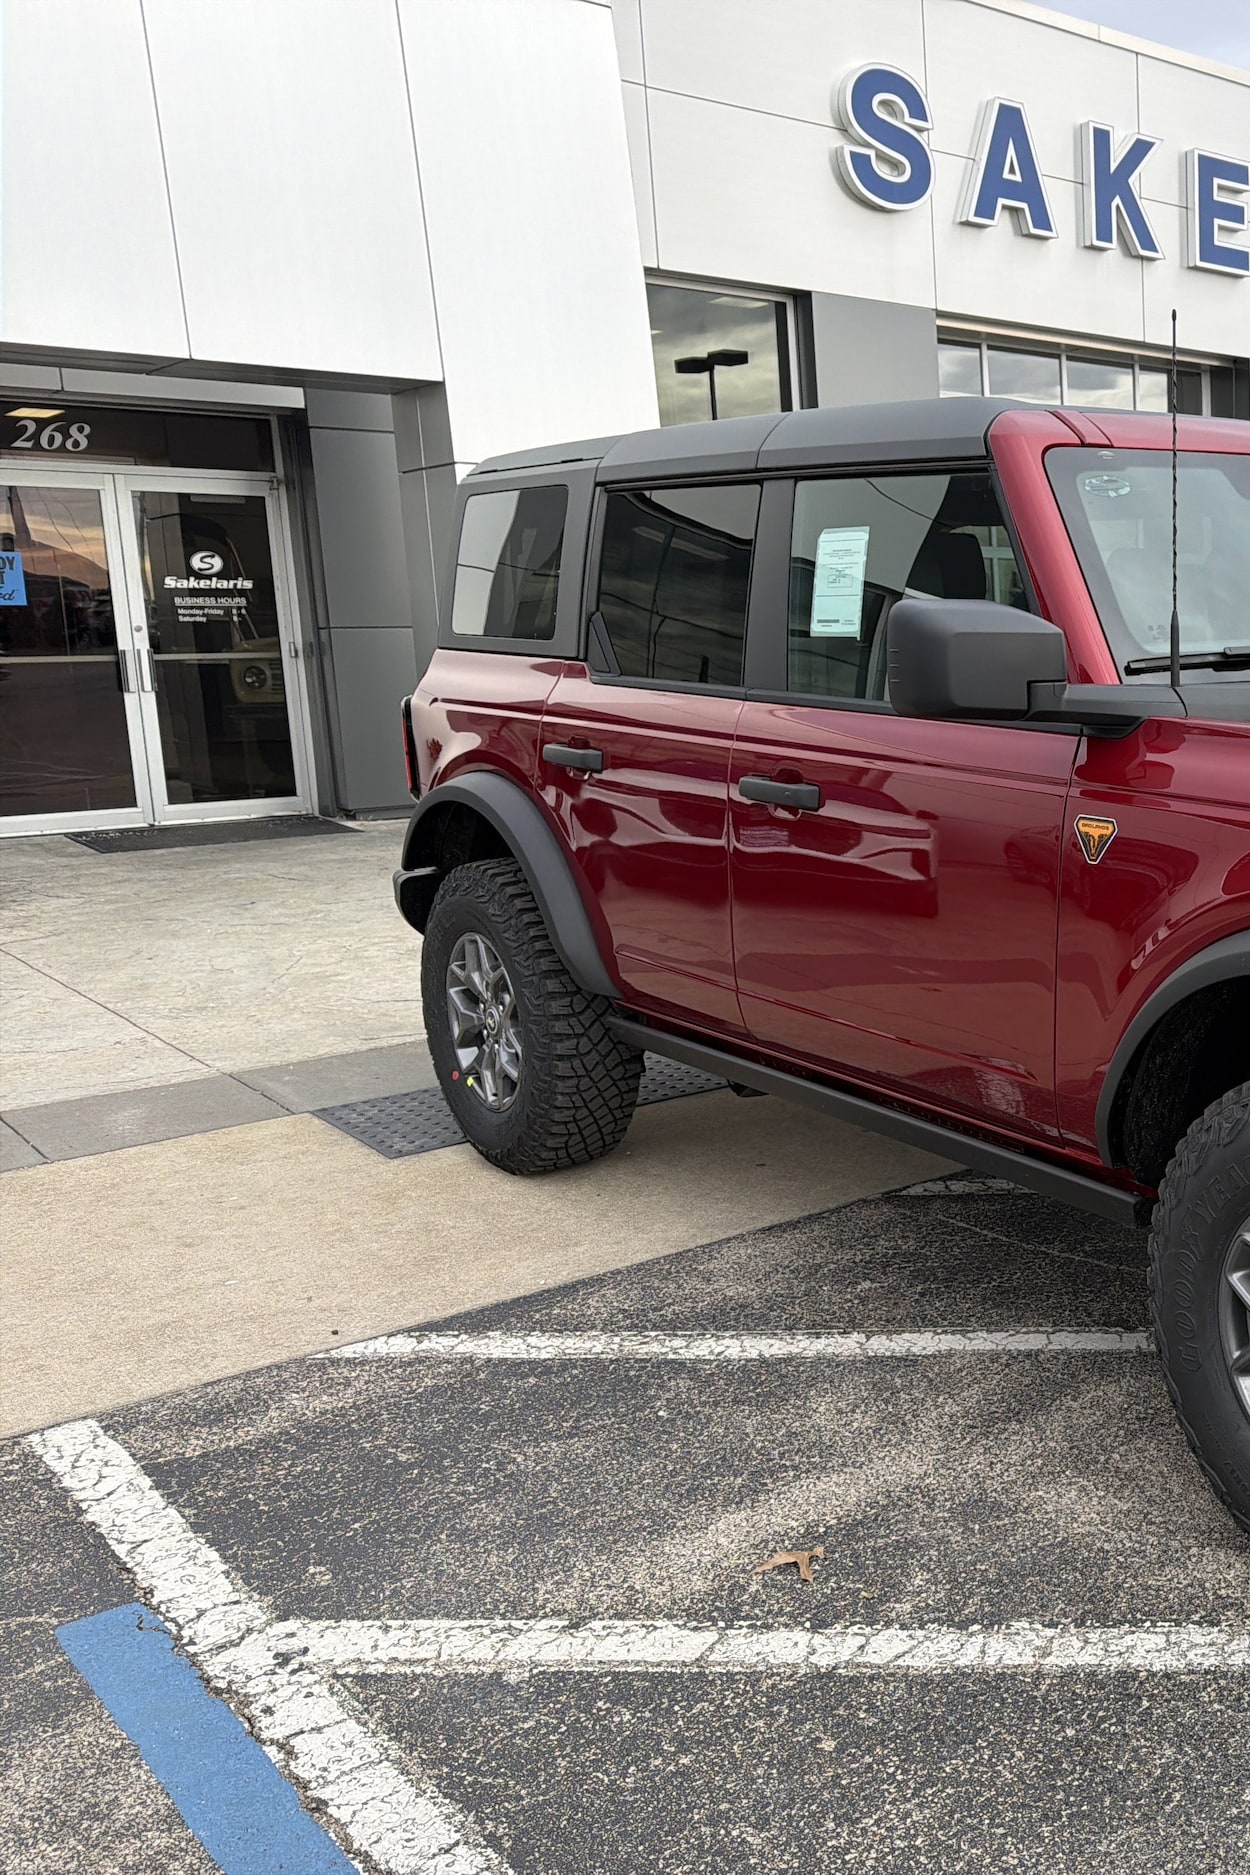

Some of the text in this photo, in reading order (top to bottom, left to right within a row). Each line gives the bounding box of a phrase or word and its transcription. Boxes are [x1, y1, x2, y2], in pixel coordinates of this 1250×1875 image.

[10, 419, 91, 451] 268
[163, 576, 254, 590] Sakelaris
[217, 597, 246, 605] HOURS
